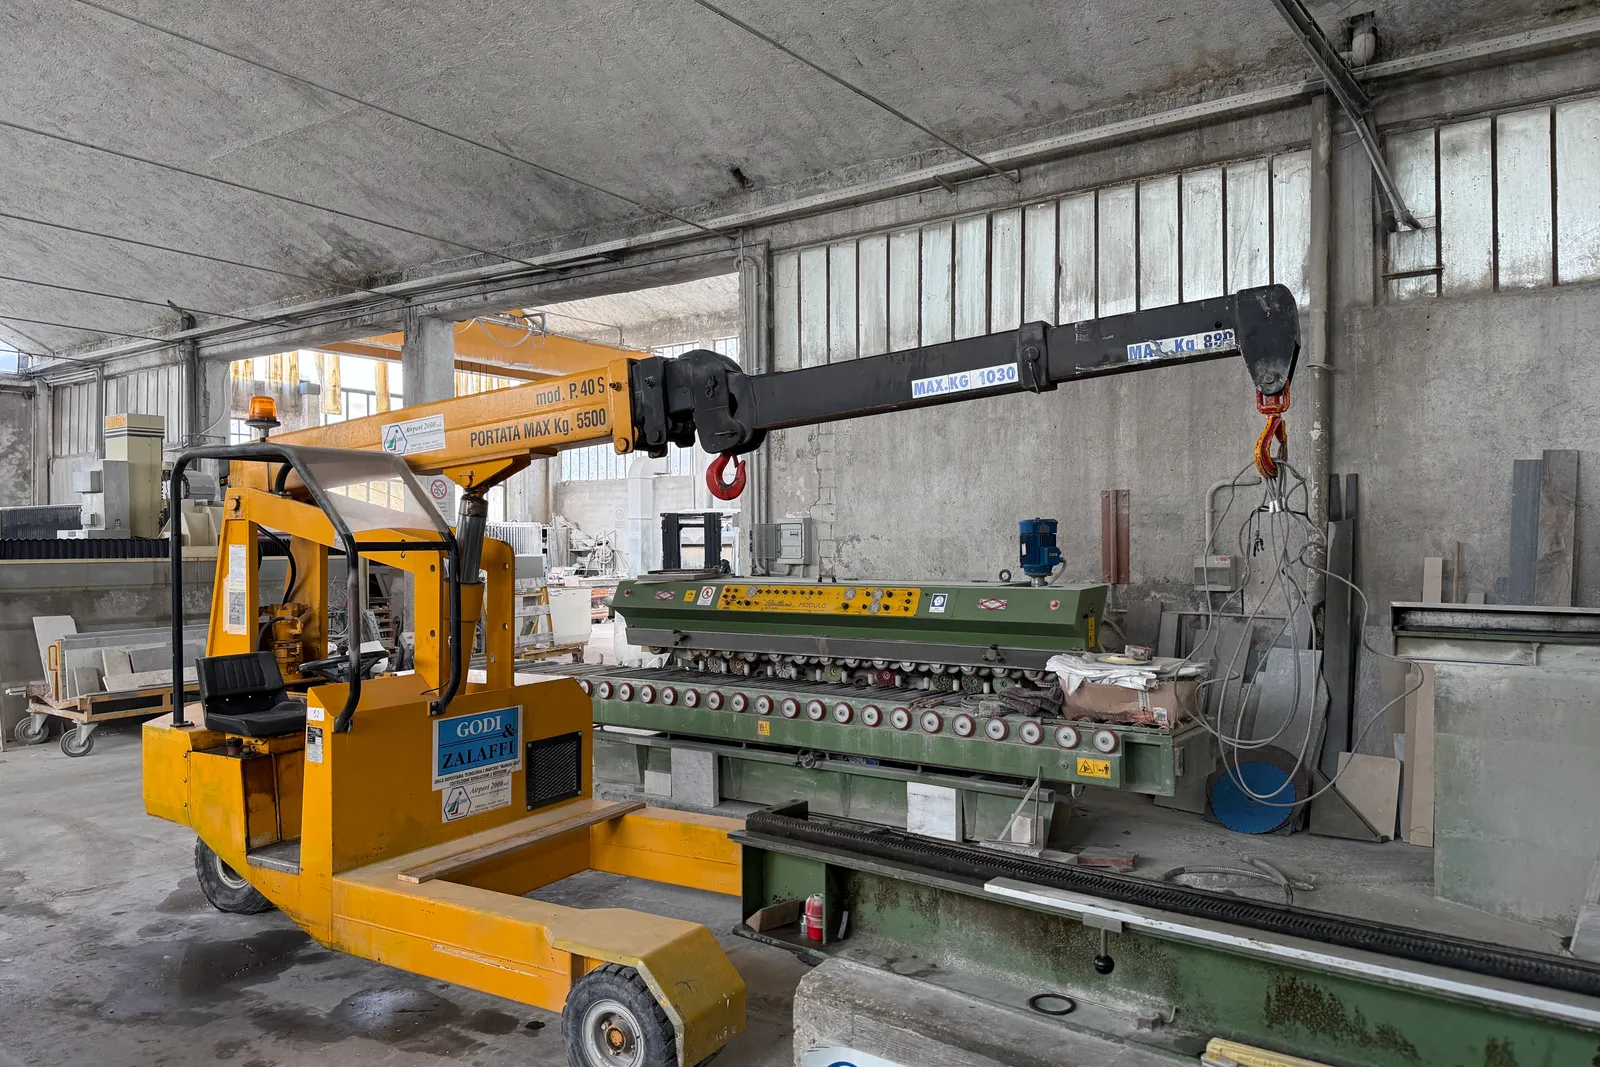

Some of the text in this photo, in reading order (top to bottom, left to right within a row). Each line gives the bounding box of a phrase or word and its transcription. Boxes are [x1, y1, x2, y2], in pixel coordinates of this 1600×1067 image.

[979, 366, 1016, 385] 1030
[536, 386, 565, 406] mod.
[470, 425, 521, 448] PORTATA
[524, 418, 551, 439] MAX
[576, 408, 606, 429] 5500
[456, 716, 515, 738] GODI &
[442, 740, 514, 769] ZALAFFI
[470, 784, 490, 794] Airport
[490, 779, 504, 789] 2000
